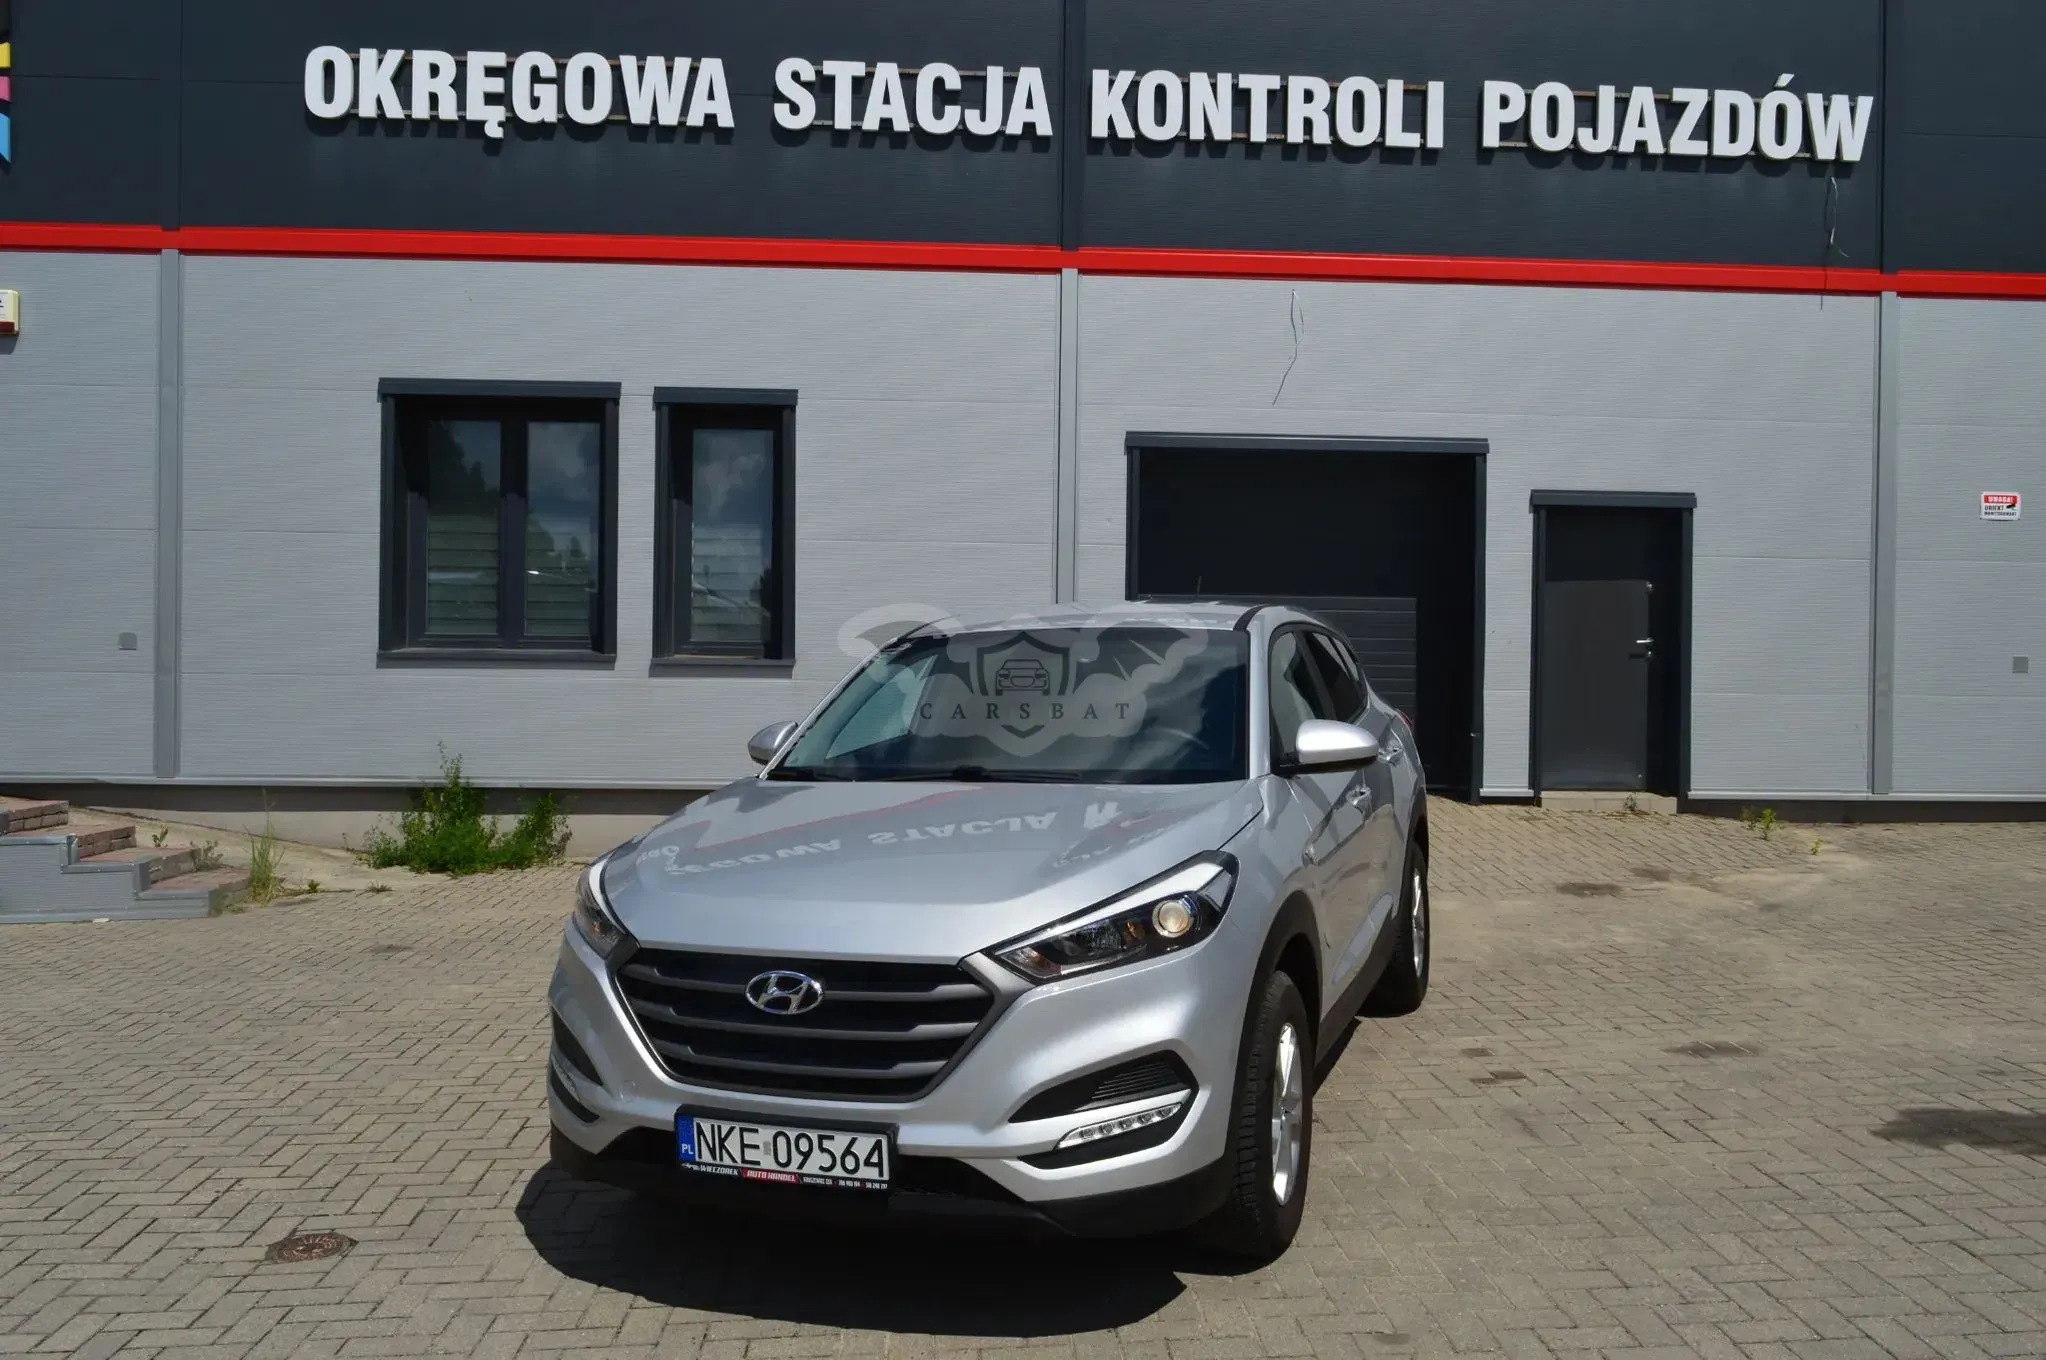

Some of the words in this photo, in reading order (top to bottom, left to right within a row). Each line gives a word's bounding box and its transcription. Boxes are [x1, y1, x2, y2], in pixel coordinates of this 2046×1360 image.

[304, 45, 735, 139] OKRĘGOWA
[773, 57, 1053, 138] STACJA
[1091, 68, 1445, 150] KONTROLI
[1482, 73, 1874, 163] POJAZDÓW
[681, 1143, 694, 1155] PL
[695, 1121, 761, 1166] NKE
[772, 1130, 885, 1178] 09564
